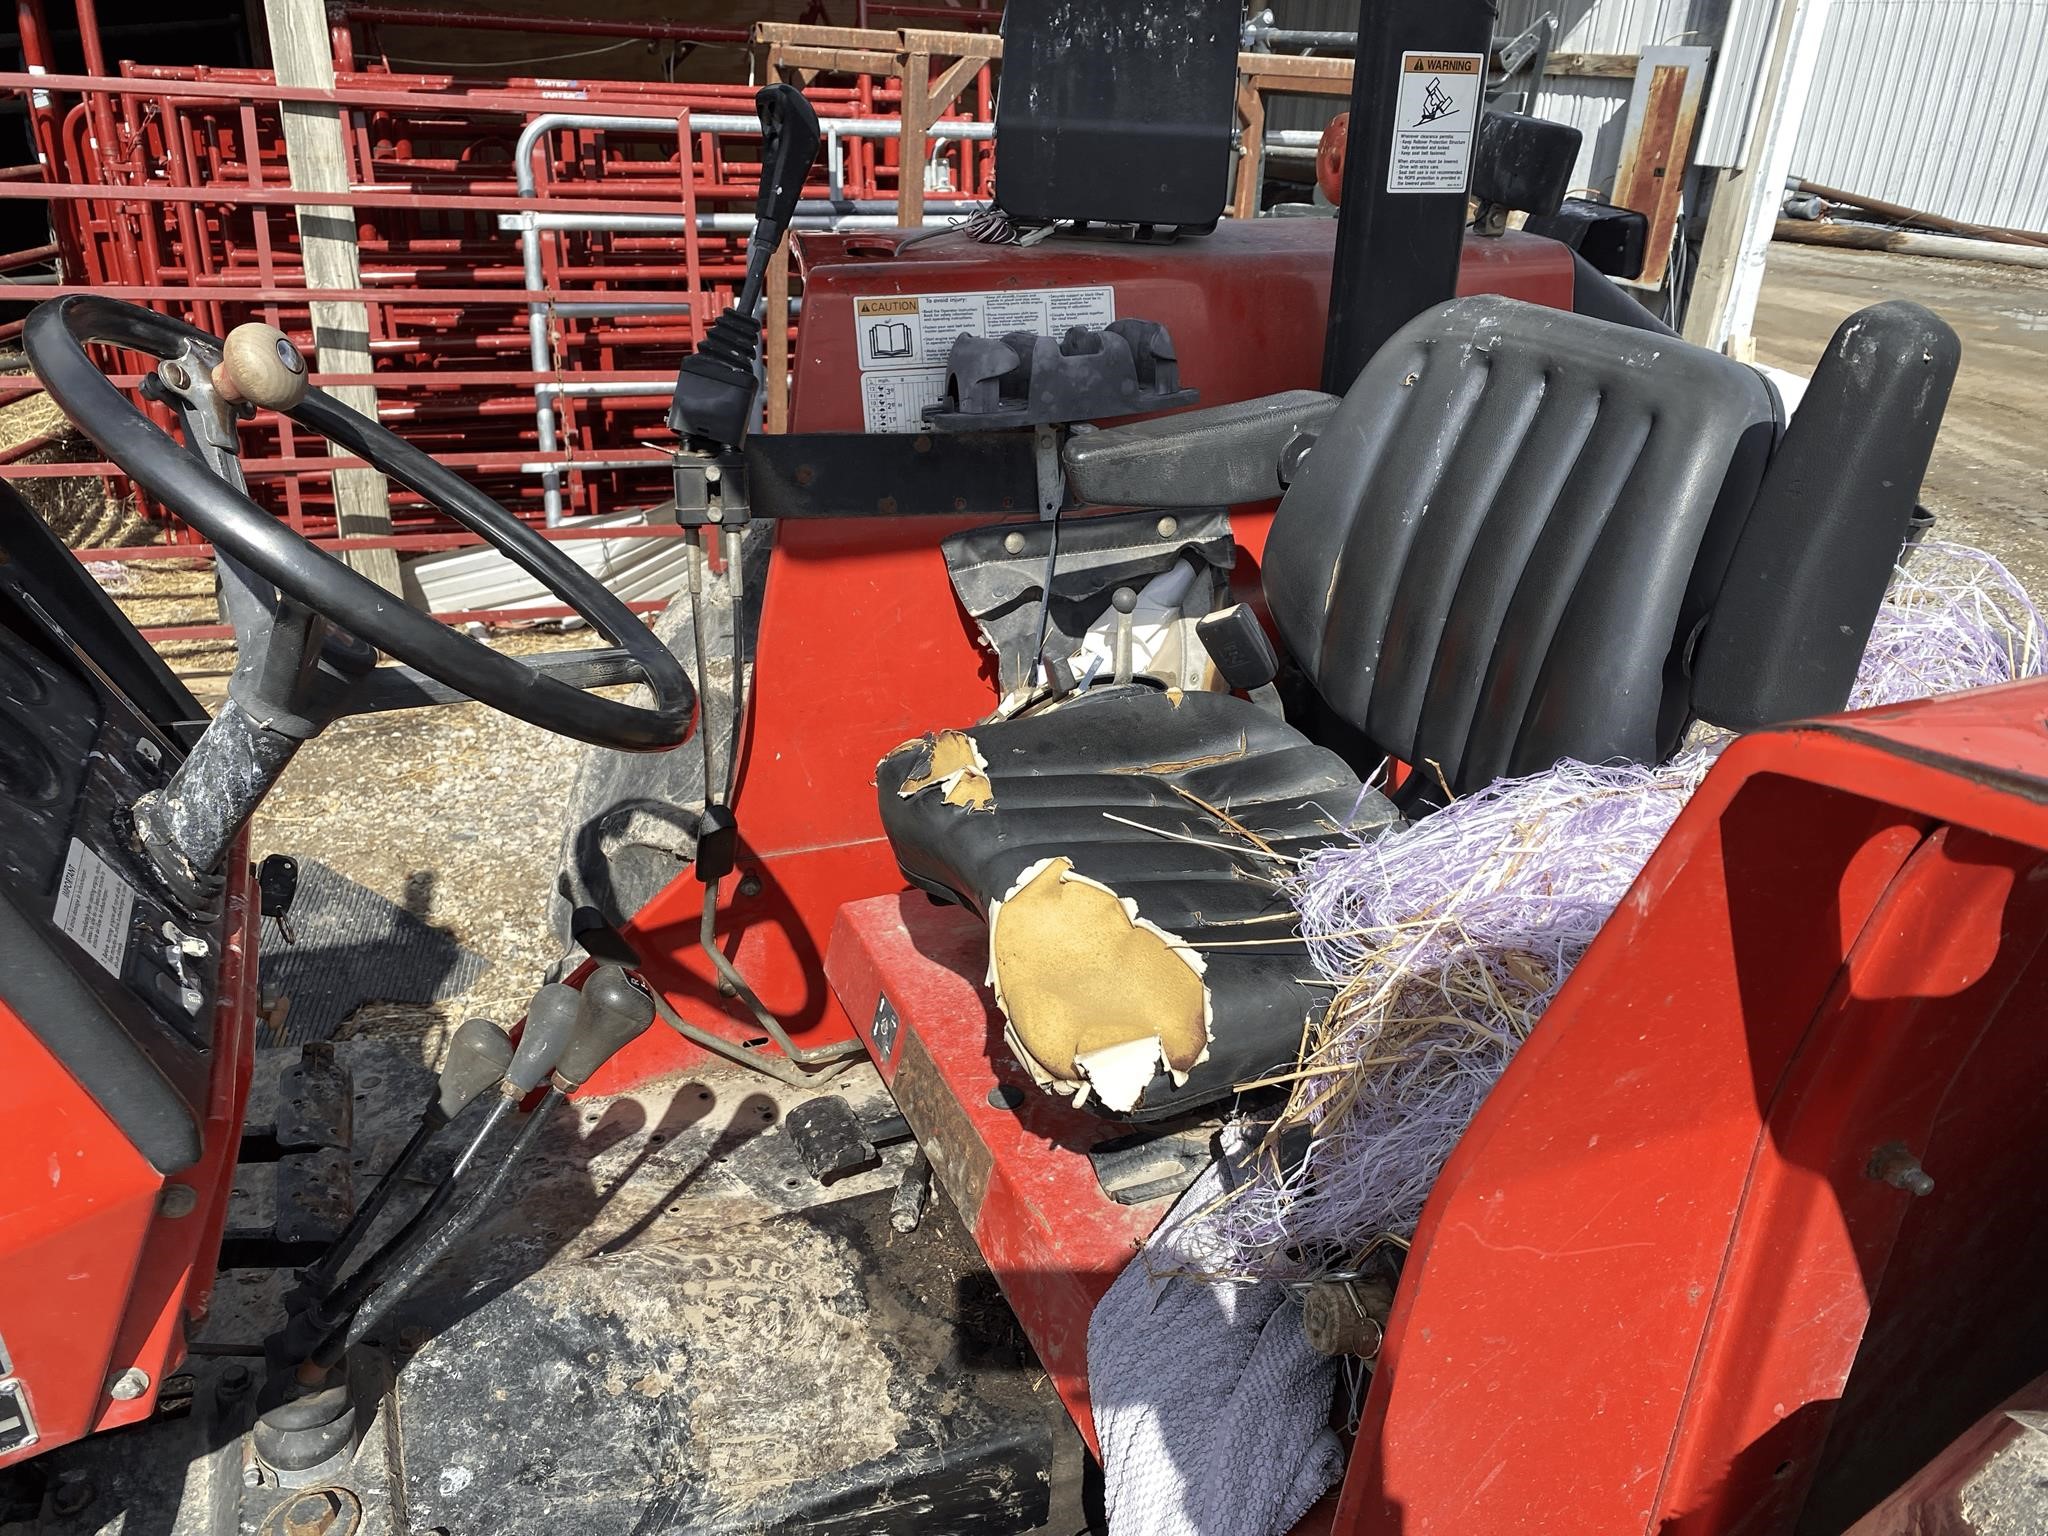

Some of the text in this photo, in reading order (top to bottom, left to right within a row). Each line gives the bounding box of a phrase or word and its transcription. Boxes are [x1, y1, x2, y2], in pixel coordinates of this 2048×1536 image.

[1427, 59, 1472, 71] WARNING
[871, 301, 917, 312] CAUTION
[62, 864, 76, 898] IMPORTANT
